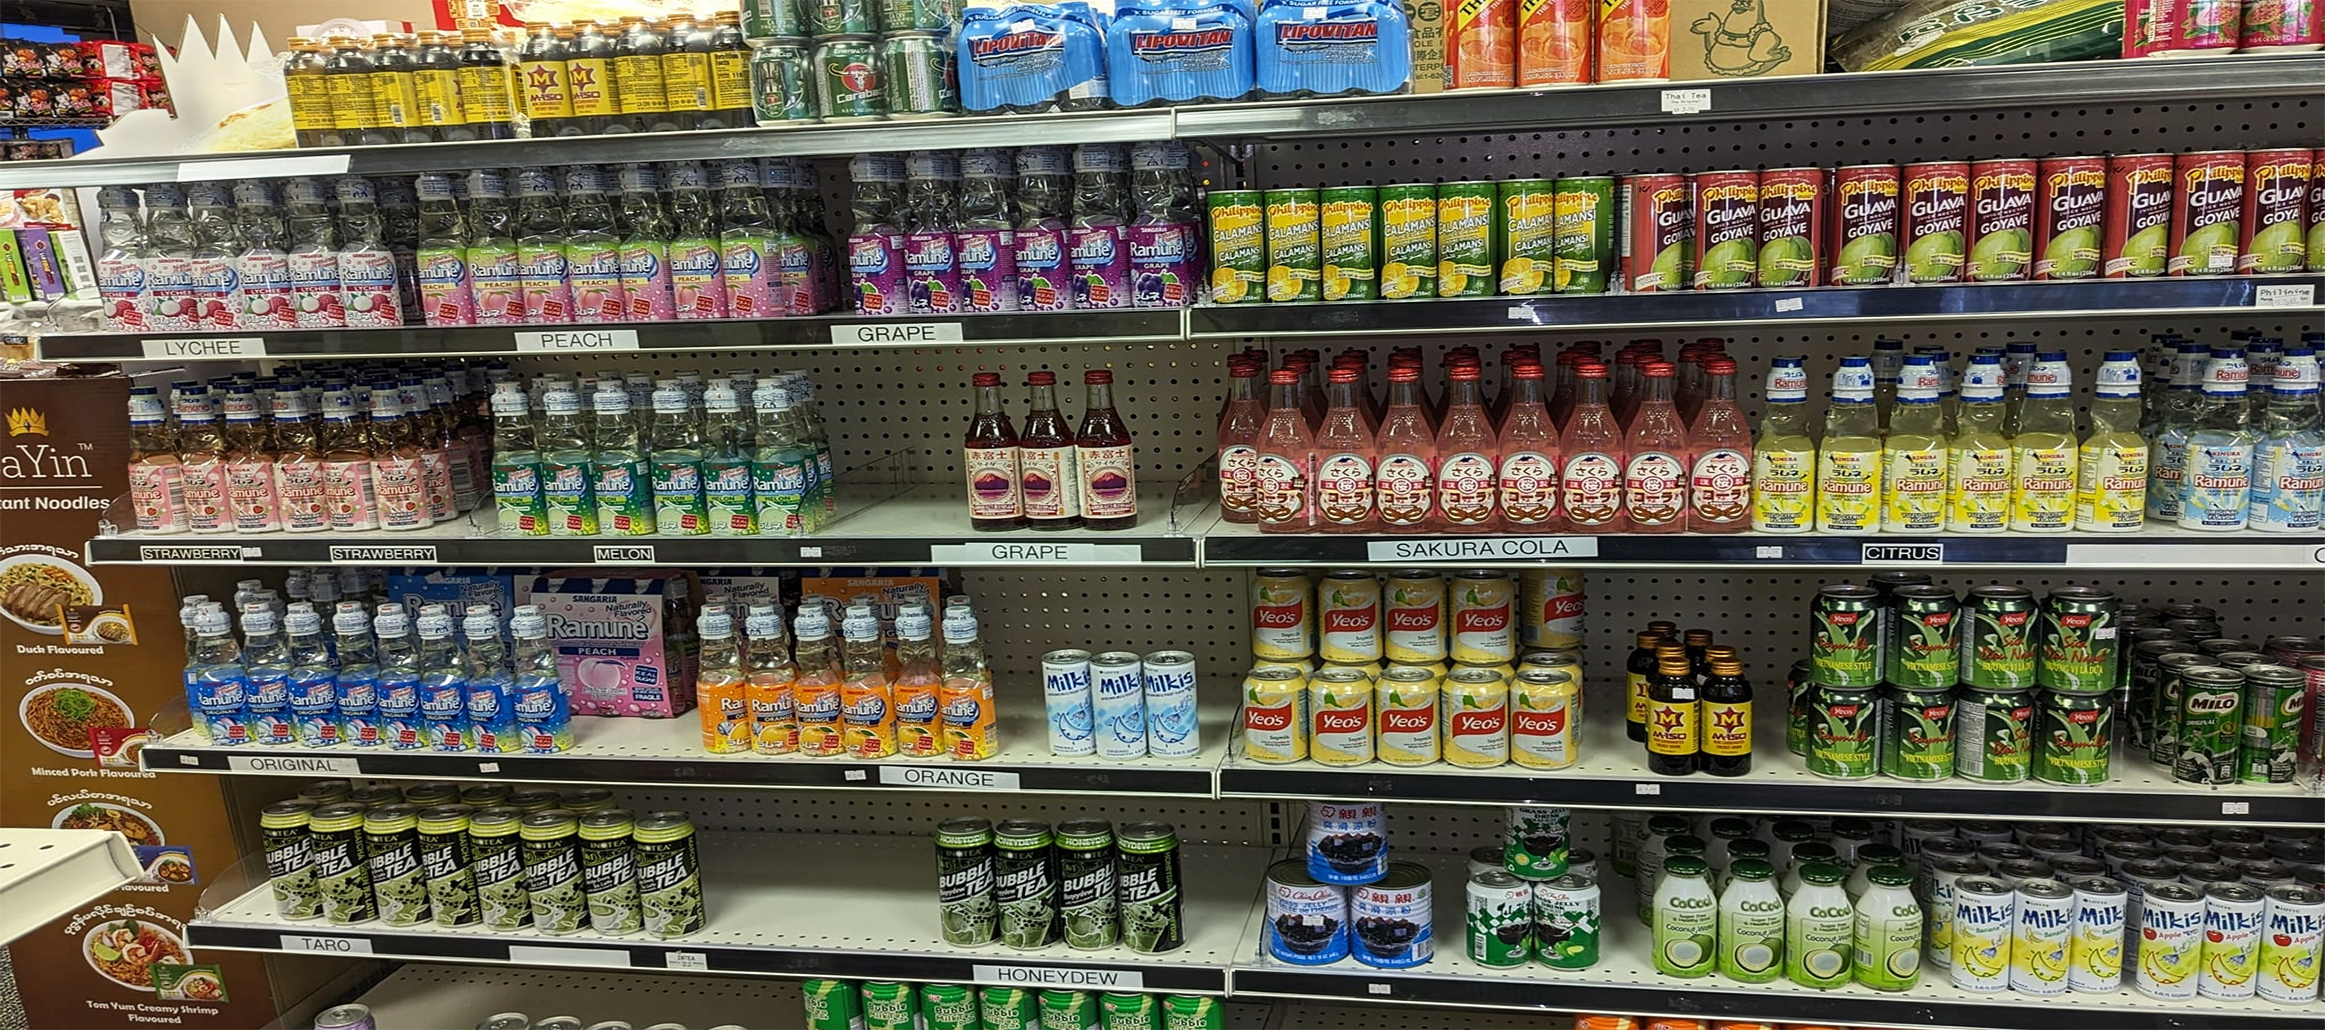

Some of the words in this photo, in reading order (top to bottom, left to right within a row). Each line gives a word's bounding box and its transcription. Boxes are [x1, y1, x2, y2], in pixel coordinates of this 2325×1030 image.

[1280, 24, 1377, 40] LIPOVITAN
[1135, 31, 1230, 49] LIPOVITAN
[1691, 92, 1707, 100] Tea
[1977, 192, 2032, 215] GUAVA
[2189, 185, 2243, 207] GUAVA
[1760, 202, 1811, 223] GUAVA
[1843, 198, 1896, 219] GUAVA
[1911, 194, 1966, 217] GUAVA
[1706, 203, 1756, 225] GUAVA
[1847, 218, 1894, 239] GOYAVE
[1915, 216, 1962, 236] GOYAVE
[1980, 213, 2029, 234] GOYAVE
[1710, 223, 1755, 243] GOYAVE
[1762, 221, 1808, 242] GOYAVE
[541, 333, 612, 348] PEACH
[857, 326, 937, 342] GRAPE
[165, 340, 242, 356] LYCHEE
[2, 443, 93, 479] aYin
[971, 450, 1008, 461] 赤富士
[1089, 449, 1126, 460] 赤富士
[1329, 467, 1362, 478] さくら
[1385, 467, 1418, 479] さくら
[1511, 466, 1545, 477] さくら
[1575, 467, 1608, 477] さくら
[1706, 463, 1740, 475] さくら
[1759, 480, 1809, 493] Ramune
[1823, 480, 1872, 494] Ramune
[2023, 478, 2074, 490] Ramune
[2193, 476, 2249, 489] Ramune
[35, 496, 110, 510] Noodles
[143, 548, 240, 560] STRAWBERRY
[332, 548, 433, 560] STRAWBERRY
[597, 548, 651, 560] MELON
[992, 544, 1068, 560] GRAPE
[1396, 541, 1494, 558] SAKURA
[1501, 539, 1569, 556] COLA
[1866, 547, 1940, 560] CITRUS
[572, 595, 618, 604] SANGARIA
[605, 600, 649, 613] Naturally
[613, 607, 652, 618] Flavored
[1259, 609, 1295, 624] Yeo's
[1394, 612, 1432, 627] Yeo's
[1465, 612, 1504, 627] Yeo's
[546, 614, 649, 640] Ramuné
[17, 644, 46, 655] Duck
[47, 644, 104, 655] Flavoured
[578, 648, 617, 656] PEACH
[1815, 660, 1851, 671] VIETNAMESE
[1852, 661, 1872, 671] STYLE
[1145, 671, 1194, 693] Milkis
[2191, 698, 2235, 710] MILO
[764, 715, 794, 723] ORANGE
[1248, 712, 1285, 727] Yeo's
[1389, 713, 1428, 729] Yeo's
[1517, 716, 1558, 732] Yeo's
[250, 758, 338, 772] ORIGINAL
[1815, 752, 1852, 763] VIETNAMESE
[1852, 752, 1871, 763] STYLE
[31, 767, 69, 777] Minced
[71, 768, 98, 778] Pork
[100, 769, 157, 779] Flavoured
[904, 769, 994, 787] ORANGE
[939, 834, 986, 844] HONEYDEW
[547, 861, 579, 886] TEA
[656, 866, 688, 890] TEA
[939, 857, 992, 889] BUBBLE
[115, 883, 170, 893] lavoured
[965, 871, 994, 897] TEA
[1015, 877, 1048, 898] TEA
[1956, 902, 2013, 925] Milkis
[2142, 907, 2201, 930] Milkis
[2204, 909, 2264, 932] Milkis
[1665, 923, 1696, 933] Coconut
[2158, 931, 2182, 940] Apple
[2225, 931, 2249, 941] Apple
[301, 937, 351, 952] TARO
[998, 967, 1118, 986] HONEYDEW
[86, 1000, 110, 1010] Tom
[110, 1001, 136, 1012] Yum
[137, 1003, 179, 1015] Creamy
[181, 1005, 219, 1016] Shrimp
[128, 1013, 182, 1024] Flavoured
